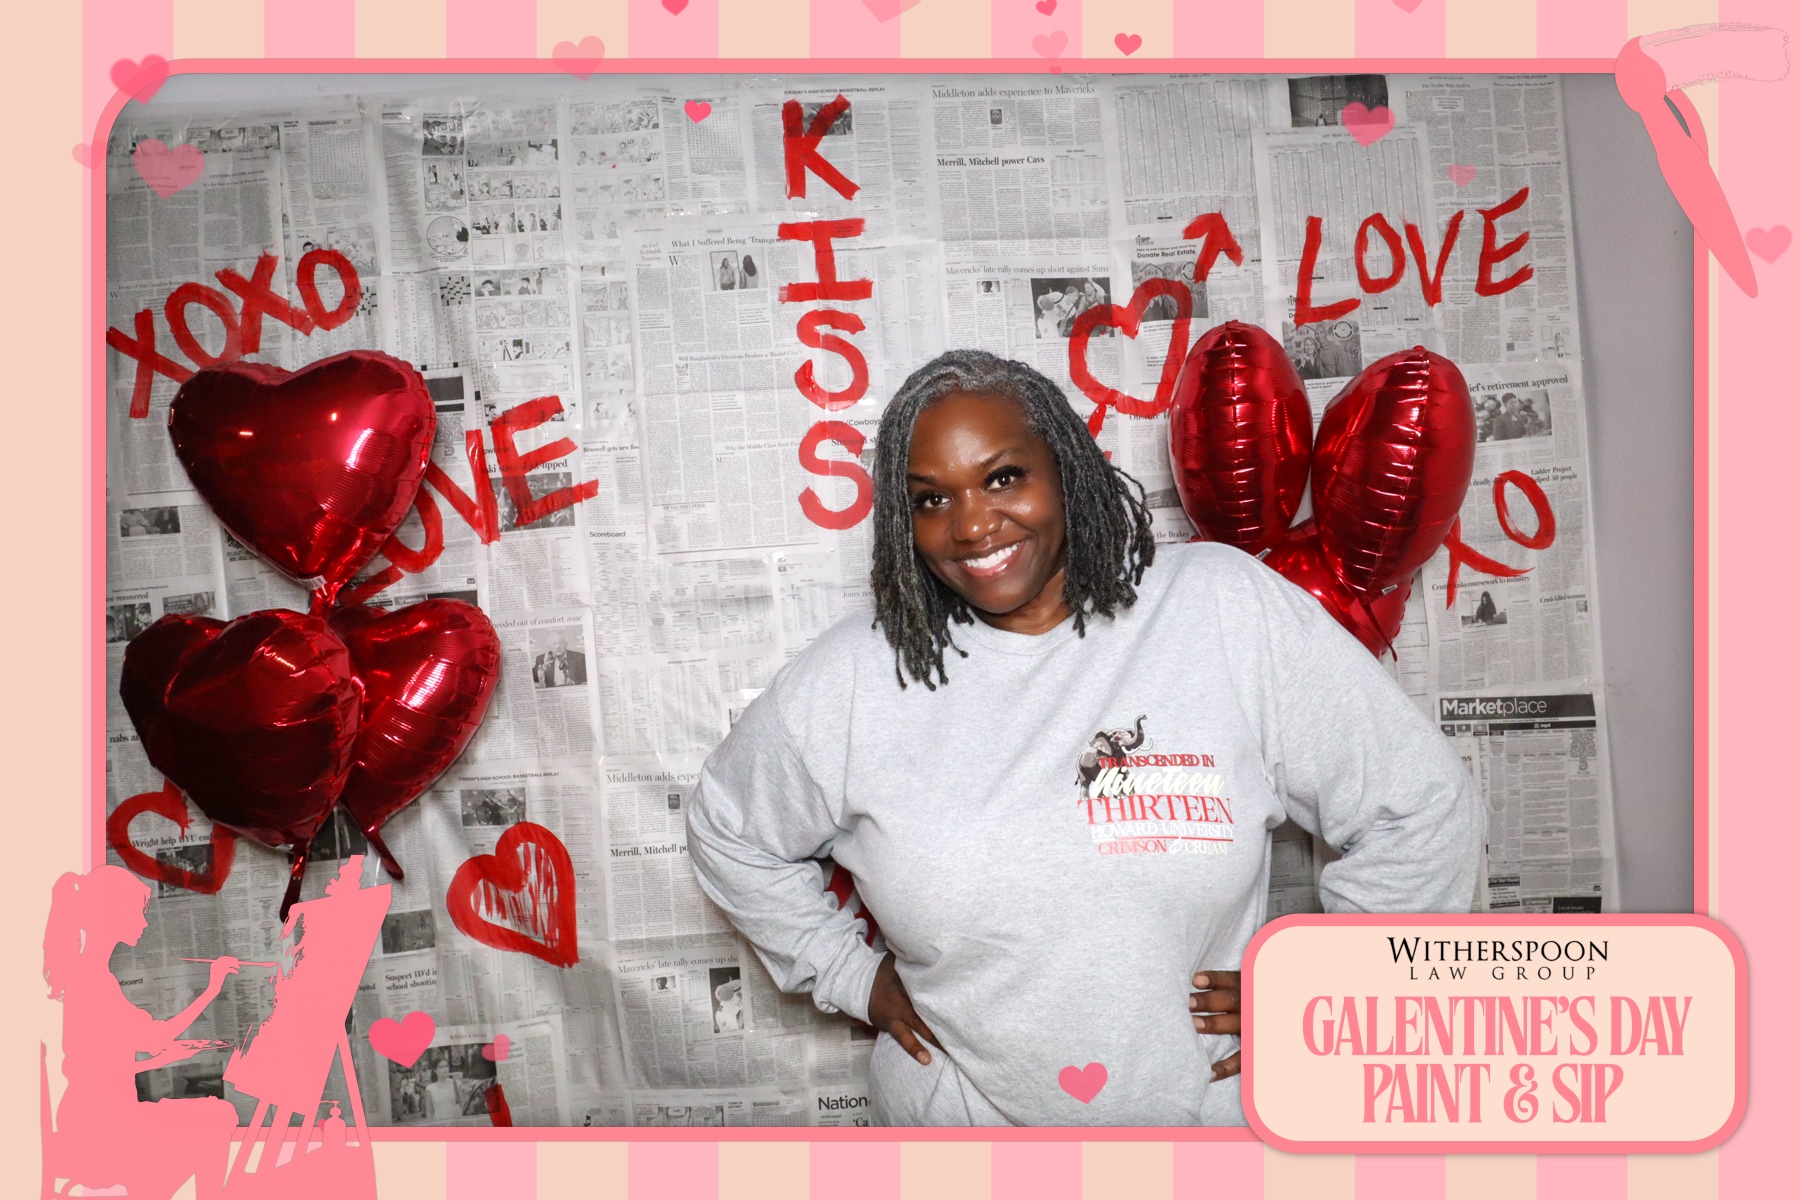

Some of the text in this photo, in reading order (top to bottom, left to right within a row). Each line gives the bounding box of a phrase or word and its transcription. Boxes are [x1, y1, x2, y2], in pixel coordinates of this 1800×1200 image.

[933, 88, 975, 98] Middleton
[978, 87, 997, 96] adds
[999, 86, 1042, 98] experience
[1056, 84, 1095, 94] Mavericks
[937, 156, 1044, 168] Merrill, Mitchell power Cavs
[672, 240, 690, 248] What
[697, 238, 725, 246] Suffered
[727, 238, 746, 246] Being
[1294, 187, 1535, 329] LOVE
[998, 266, 1011, 275] rally
[1037, 267, 1046, 275] up
[1048, 265, 1064, 273] short
[1067, 265, 1090, 274] against
[1092, 264, 1108, 272] Suns
[106, 249, 362, 419] XOXO
[1488, 382, 1529, 391] retirement
[1532, 375, 1568, 388] approved
[1553, 466, 1571, 474] Project
[1468, 579, 1498, 587] coursework
[116, 592, 148, 601] recovered
[493, 620, 516, 628] needed
[539, 617, 564, 625] comfort
[1443, 698, 1547, 717] Marketplace
[110, 734, 129, 743] nabs
[1097, 754, 1215, 769] TRANSCENDED IN
[607, 772, 652, 784] Middleton
[655, 772, 675, 781] adds
[1077, 794, 1234, 824] THIRTEEN
[1091, 823, 1234, 839] HOWARD UNIVERSITY
[132, 838, 158, 848] Wright
[161, 837, 176, 845] help
[1098, 836, 1228, 855] CRIMSON & CREAM
[611, 847, 641, 857] Merrill,
[644, 844, 677, 855] Mitchell
[658, 960, 670, 968] late
[674, 958, 688, 967] rally
[385, 969, 430, 982] Suspect ID'd
[386, 982, 408, 990] school
